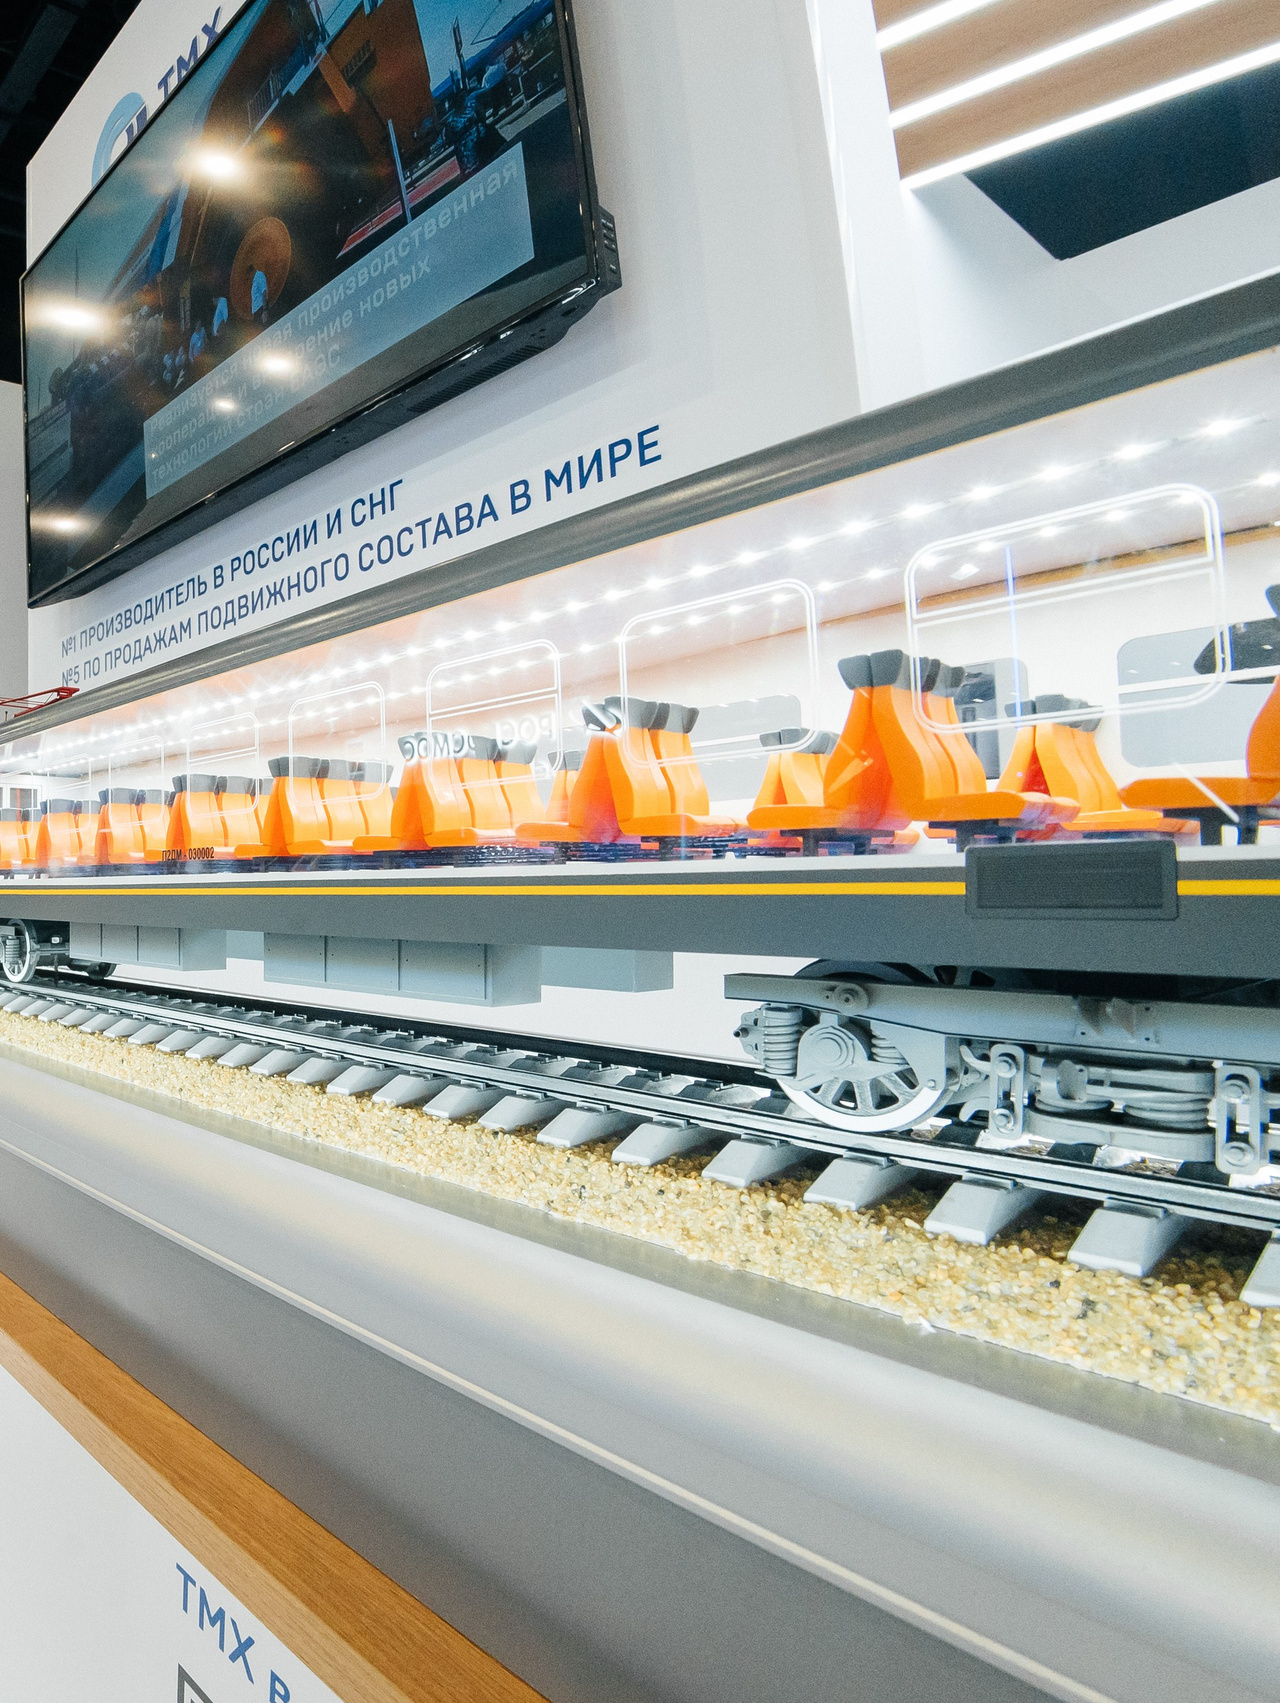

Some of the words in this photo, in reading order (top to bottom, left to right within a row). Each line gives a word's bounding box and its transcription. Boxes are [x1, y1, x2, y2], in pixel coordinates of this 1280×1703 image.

[297, 160, 519, 330] производственная
[359, 254, 432, 319] новых
[61, 664, 80, 687] №5
[83, 656, 101, 681] ПО
[104, 617, 192, 673] ПРОДАЖАМ
[197, 552, 350, 637] ПОДВИЖНОГО
[358, 493, 500, 573] СОСТАВА
[508, 479, 532, 516] В
[543, 424, 663, 503] МИРЕ
[61, 634, 77, 659] №1
[80, 573, 208, 651] ПРОИЗВОДИТЕЛЬ
[213, 564, 225, 590] В
[230, 519, 318, 582] РОССИИ
[326, 507, 343, 540] И
[350, 478, 404, 528] СНГ
[188, 846, 215, 860] 030002
[175, 1561, 256, 1686] ТМХ
